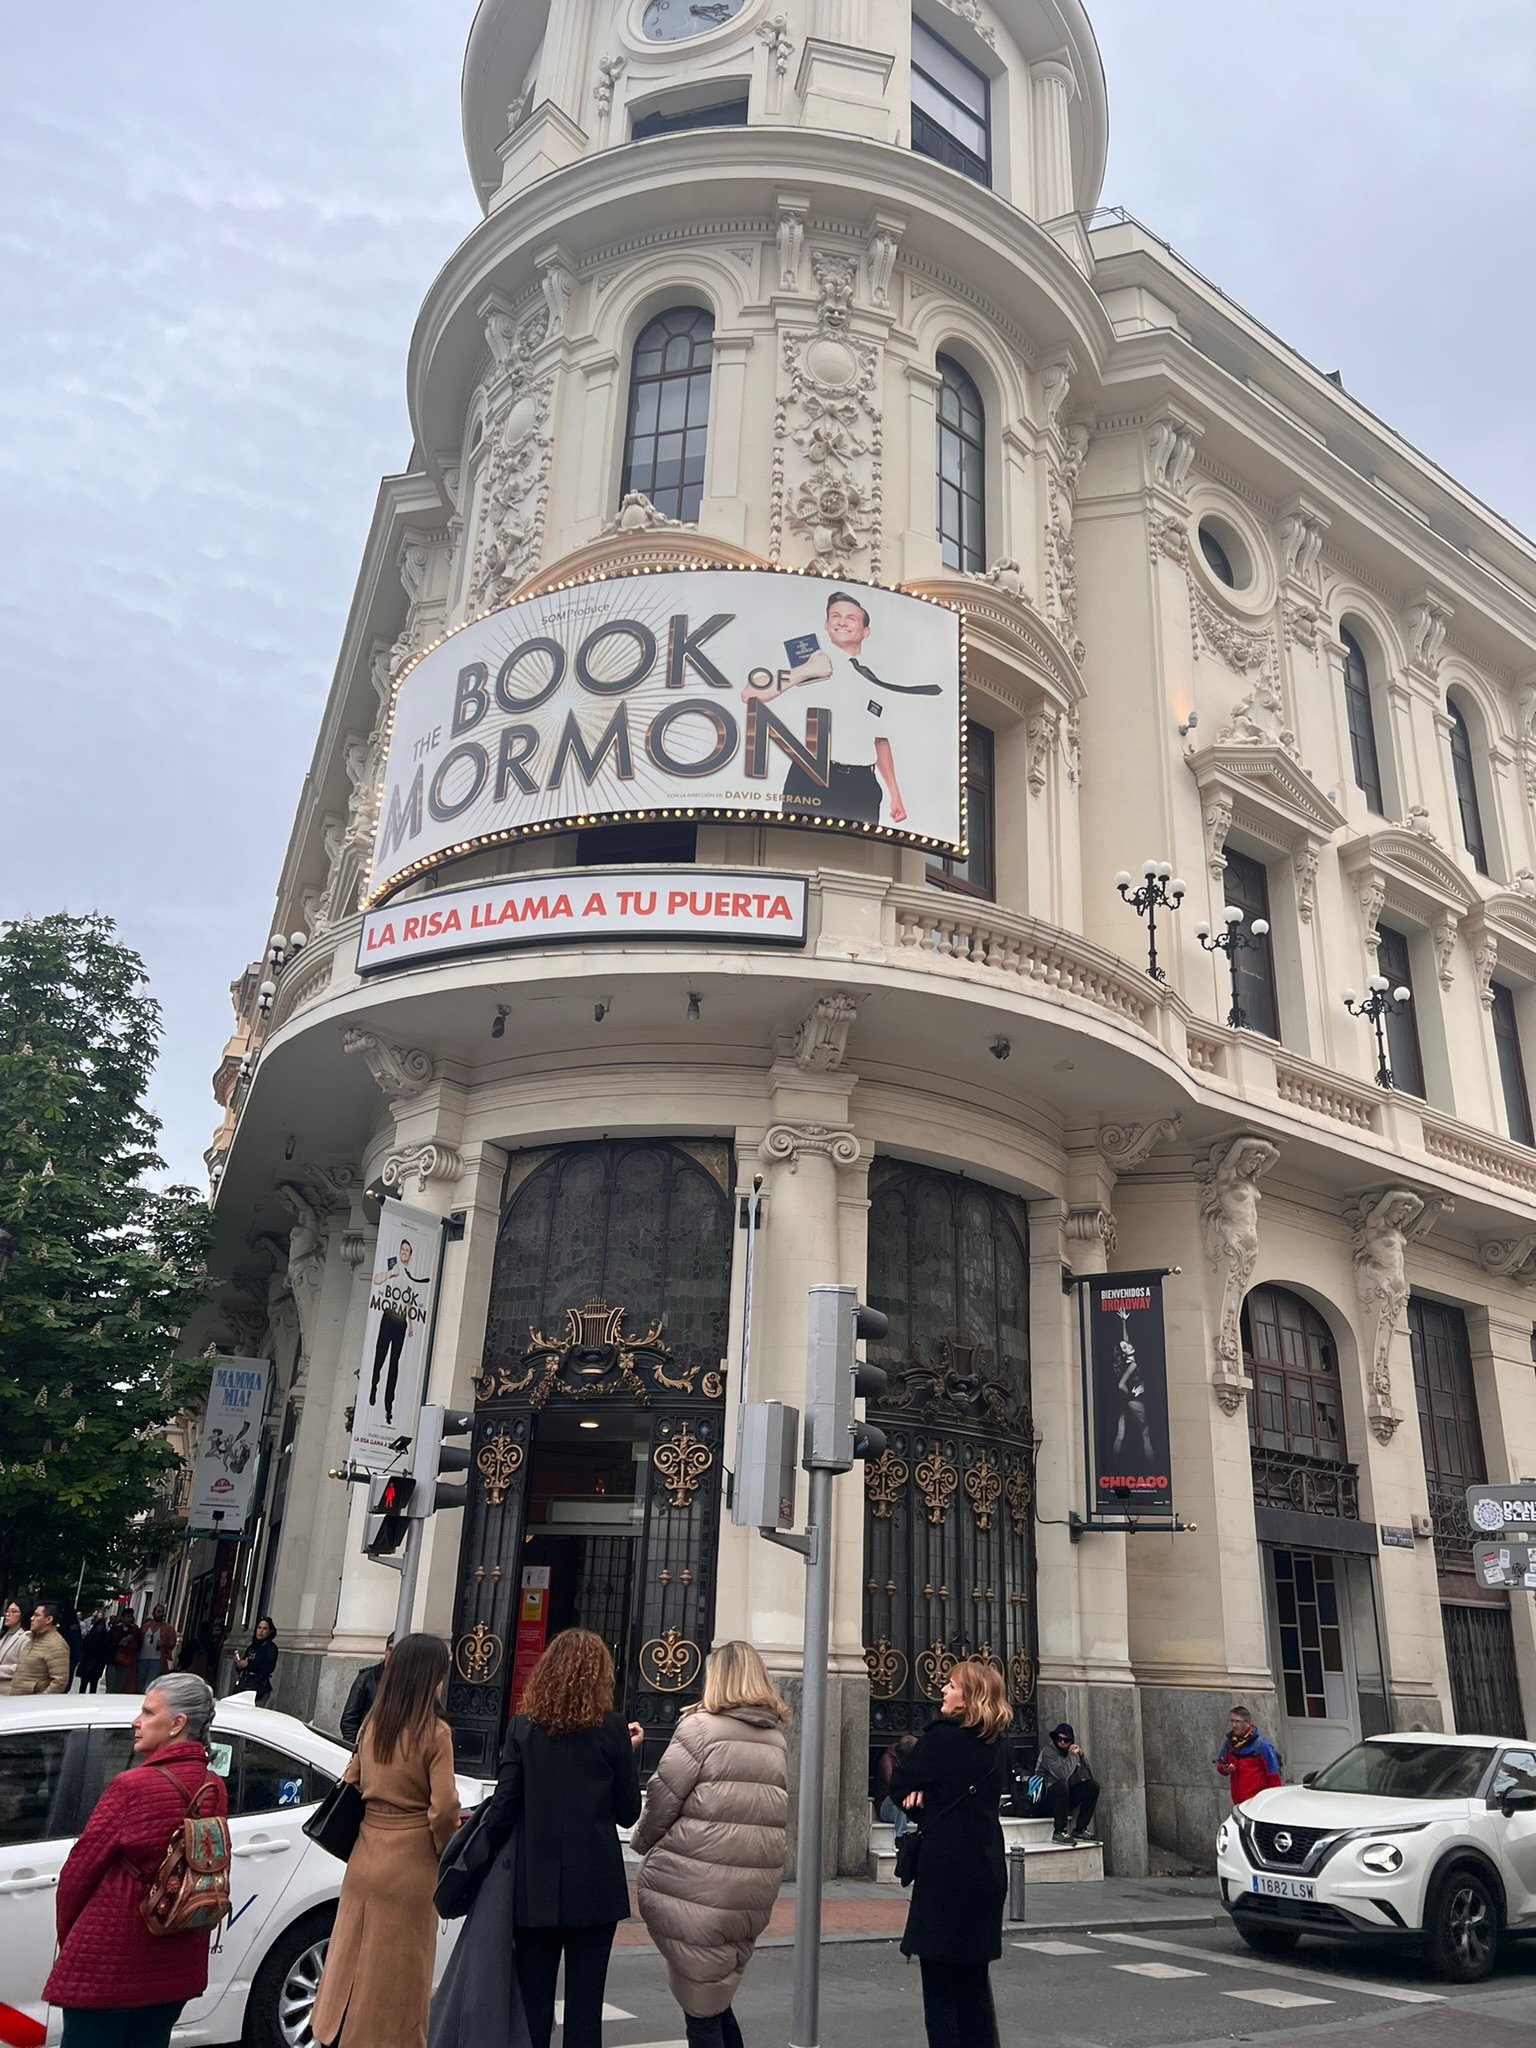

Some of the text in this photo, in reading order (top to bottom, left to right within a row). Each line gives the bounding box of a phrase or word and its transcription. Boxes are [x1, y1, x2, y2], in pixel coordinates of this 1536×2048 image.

[413, 613, 791, 762] THE BOOK OF
[378, 697, 833, 863] MORMON
[725, 791, 761, 800] DAVID
[765, 792, 822, 806] SERRANO
[366, 891, 794, 951] LA RISA LLAMA A TU PUERTA
[385, 1285, 419, 1307] BOOK
[1101, 1286, 1151, 1300] BIENVENIDOS A
[370, 1294, 427, 1324] MORMON
[1101, 1296, 1152, 1312] BROADWAY
[216, 1369, 262, 1390] MAMMA
[222, 1388, 252, 1407] MIA!
[1098, 1475, 1169, 1489] CHICAGO
[1261, 1878, 1314, 1899] 1682 LSW
